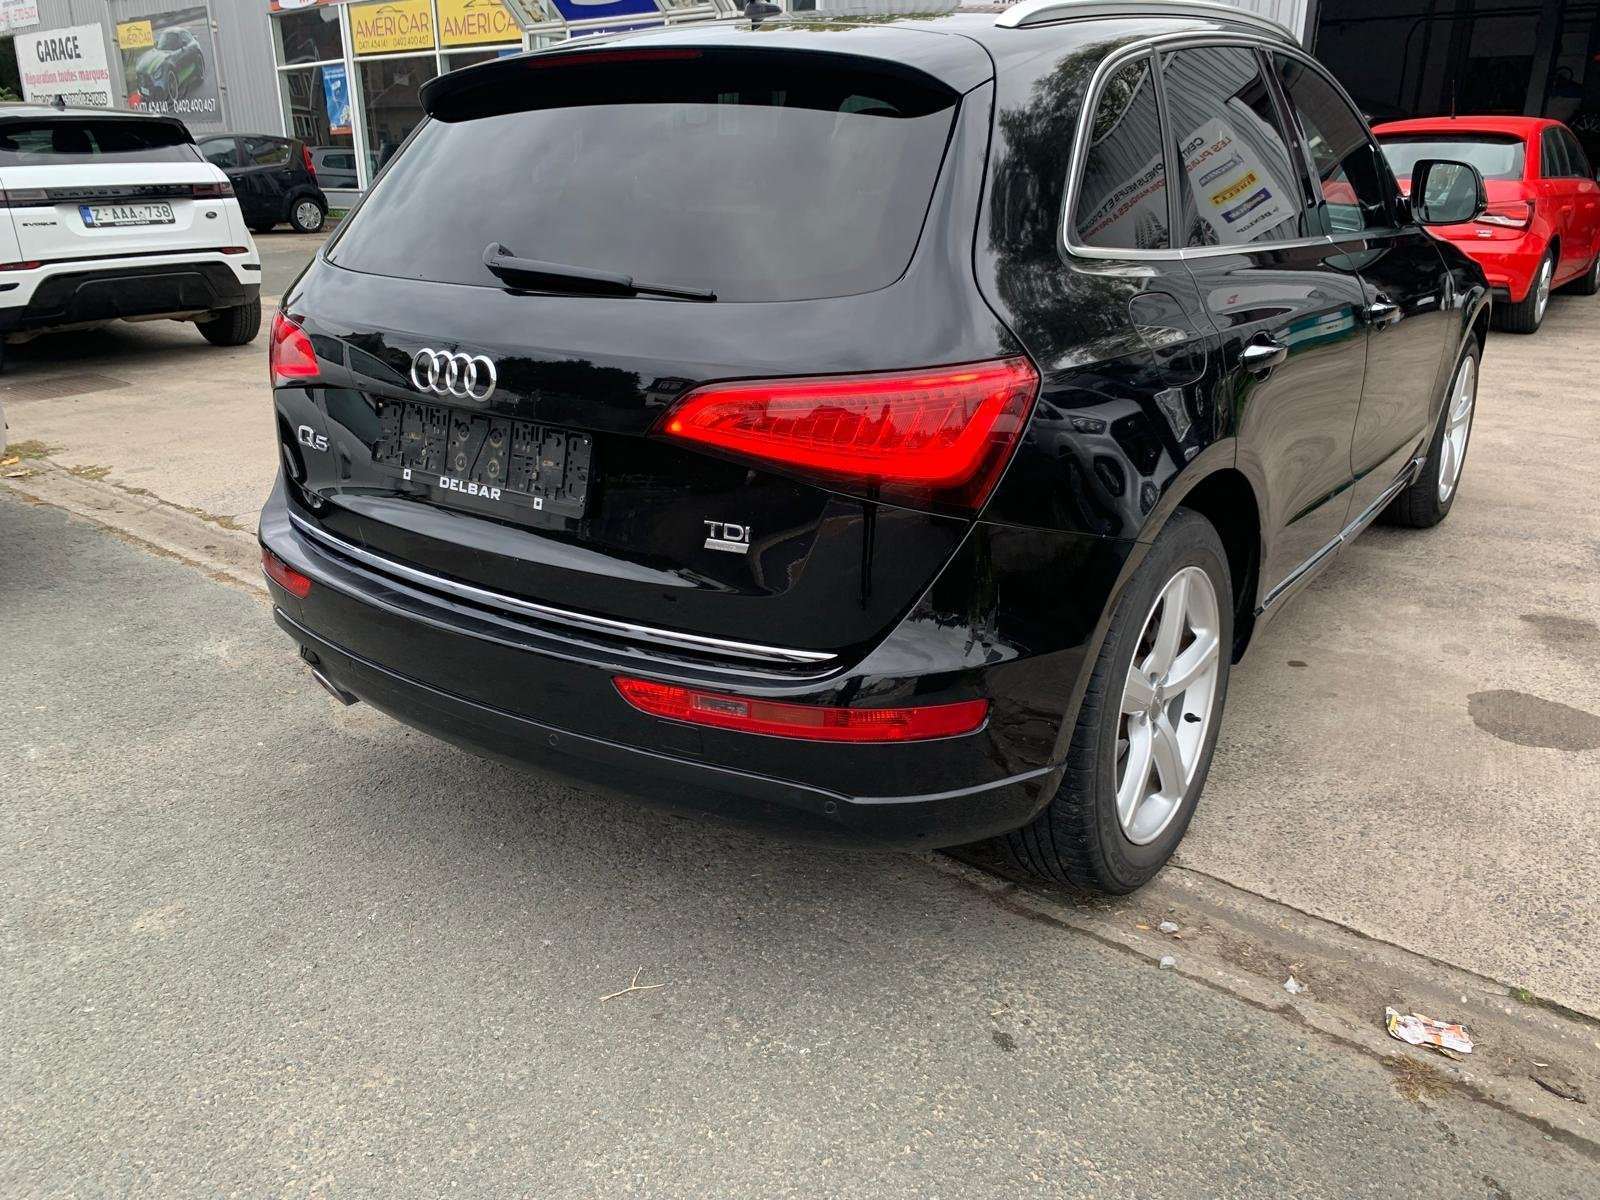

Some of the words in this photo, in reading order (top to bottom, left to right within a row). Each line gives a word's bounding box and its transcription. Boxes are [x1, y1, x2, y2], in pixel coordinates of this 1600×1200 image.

[36, 36, 81, 63] GARAGE
[79, 68, 109, 84] marques
[299, 424, 329, 452] Q5
[439, 475, 501, 501] DELBAR
[703, 519, 750, 543] TDI
